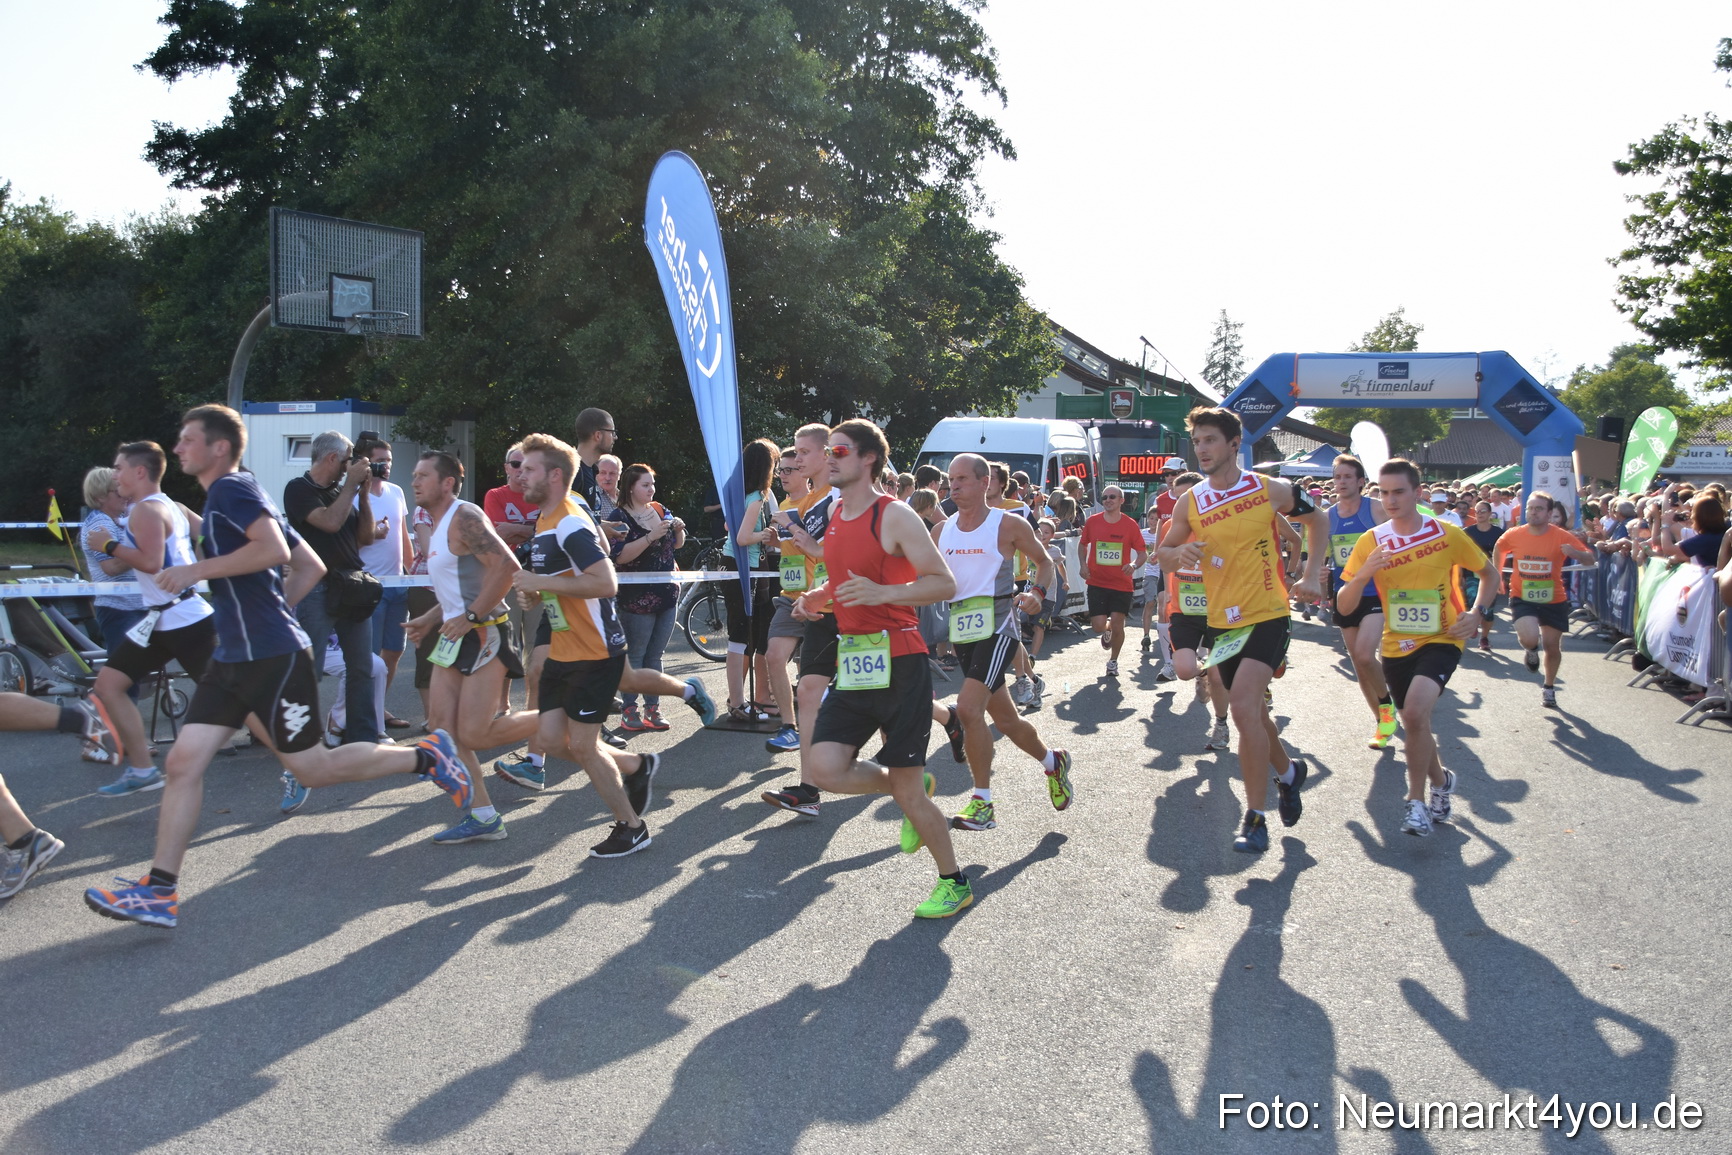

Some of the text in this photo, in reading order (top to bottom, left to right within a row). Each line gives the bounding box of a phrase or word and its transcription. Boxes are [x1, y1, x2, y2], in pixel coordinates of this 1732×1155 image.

[1367, 379, 1435, 391] firmenlauf
[1241, 401, 1276, 410] Fischer
[1624, 453, 1648, 479] AOK
[1200, 495, 1269, 528] MAX BÖGL
[1099, 551, 1120, 560] 1526
[1382, 541, 1450, 571] MAX BÖGL
[784, 570, 801, 582] 404
[1185, 596, 1207, 607] 626
[1527, 590, 1548, 599] 616
[1398, 607, 1430, 622] 935
[957, 613, 984, 632] 573
[1215, 640, 1241, 658] 878
[843, 654, 886, 675] 1364
